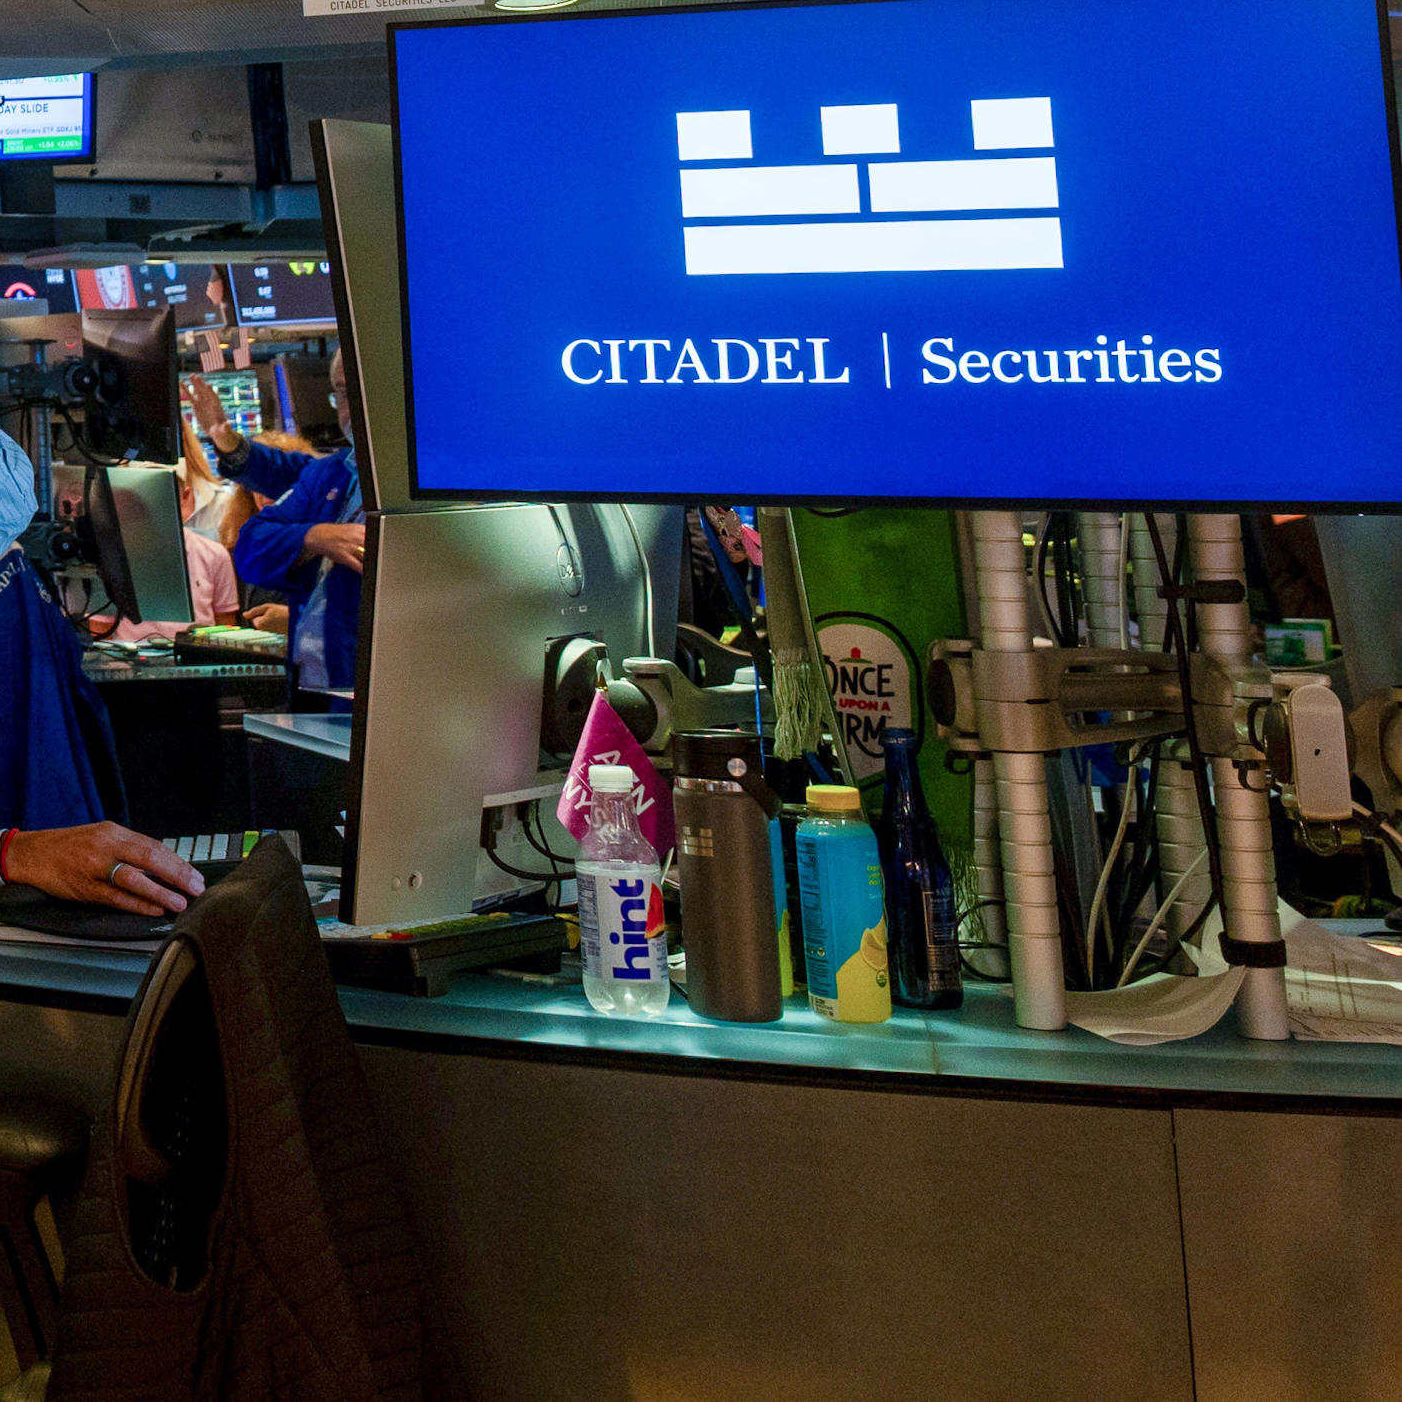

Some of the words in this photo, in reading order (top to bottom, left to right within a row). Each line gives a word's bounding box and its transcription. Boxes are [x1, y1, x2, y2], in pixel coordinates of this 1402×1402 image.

[331, 0, 369, 10] CITADEL
[562, 338, 849, 384] CITADEL
[922, 335, 1222, 383] Securities
[839, 698, 878, 711] UPON
[881, 701, 891, 712] A
[609, 878, 651, 980] hint
